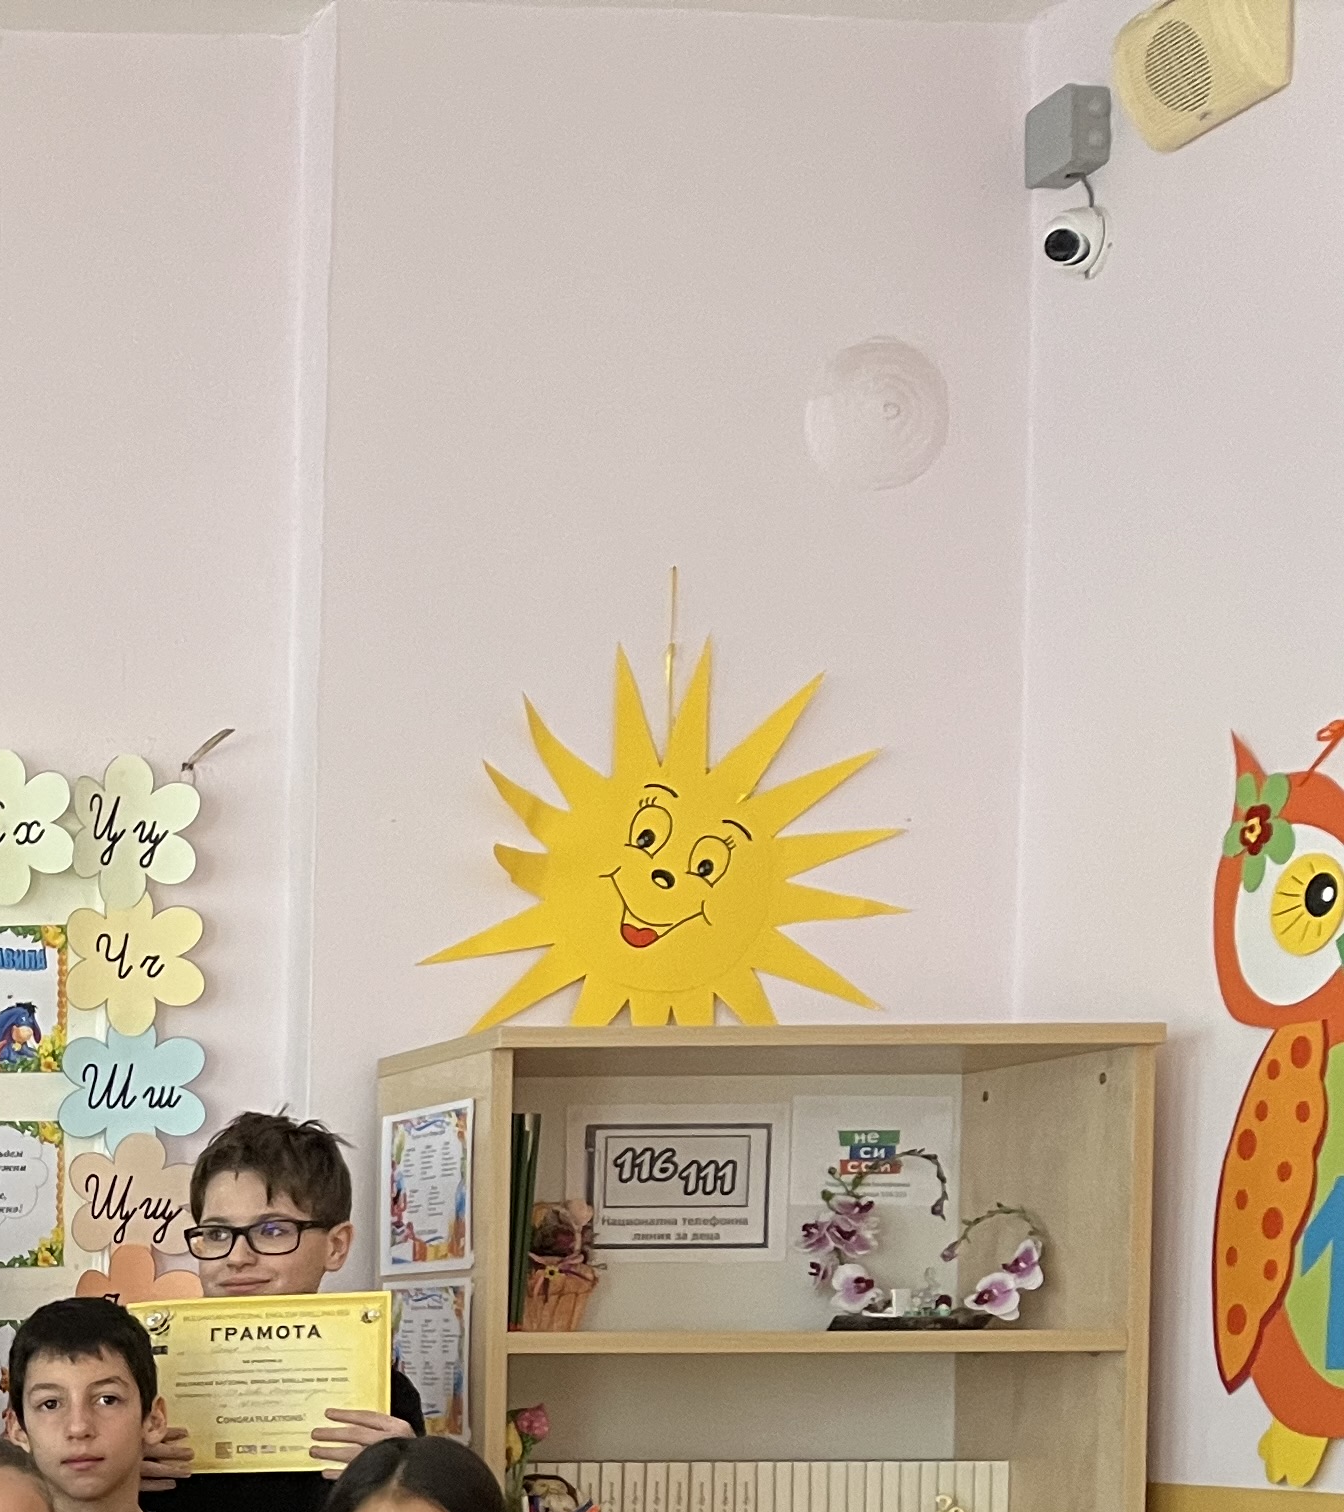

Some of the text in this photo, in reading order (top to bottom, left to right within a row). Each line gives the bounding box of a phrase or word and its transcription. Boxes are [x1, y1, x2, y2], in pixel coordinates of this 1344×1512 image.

[614, 1147, 737, 1196] 116 111
[211, 1324, 322, 1342] ГРАМОТА
